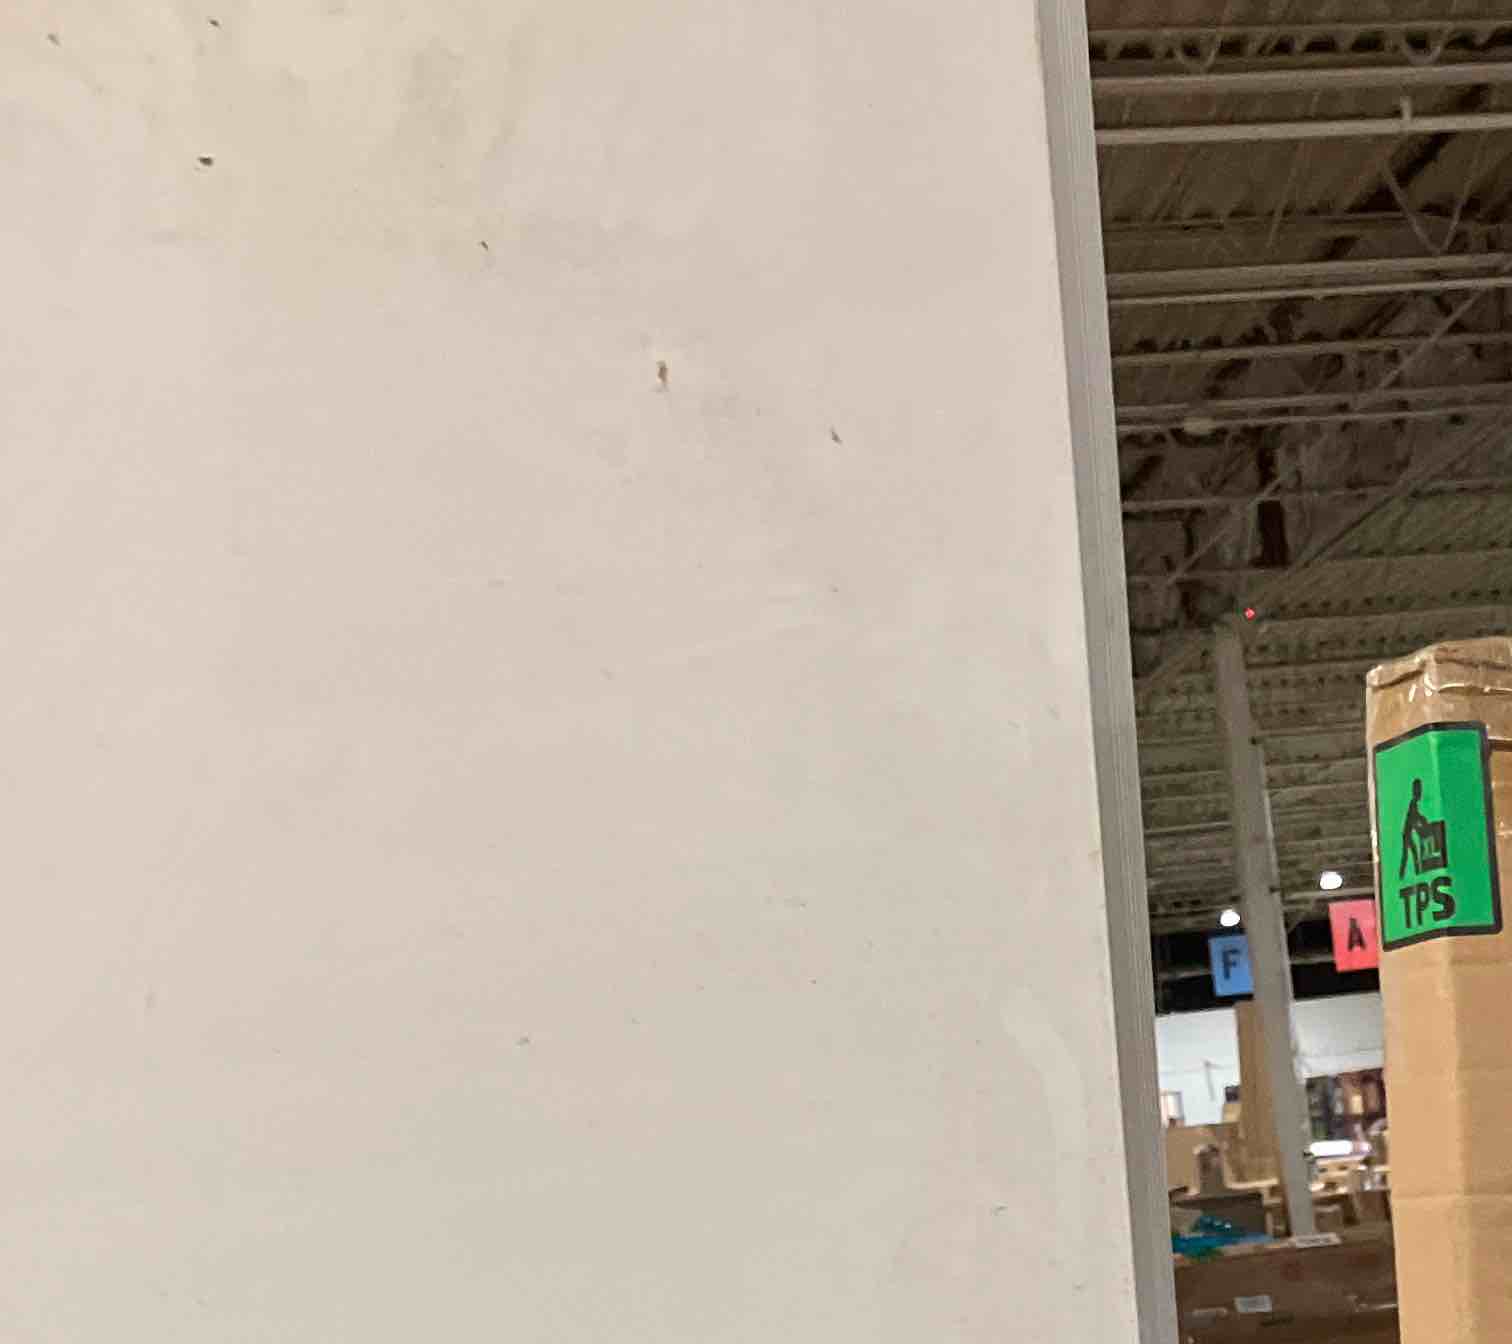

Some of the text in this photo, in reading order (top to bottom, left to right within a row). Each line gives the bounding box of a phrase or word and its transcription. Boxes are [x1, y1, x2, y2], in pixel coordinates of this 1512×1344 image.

[1399, 876, 1456, 929] TPS
[1347, 918, 1368, 951] A
[1222, 948, 1241, 980] F
